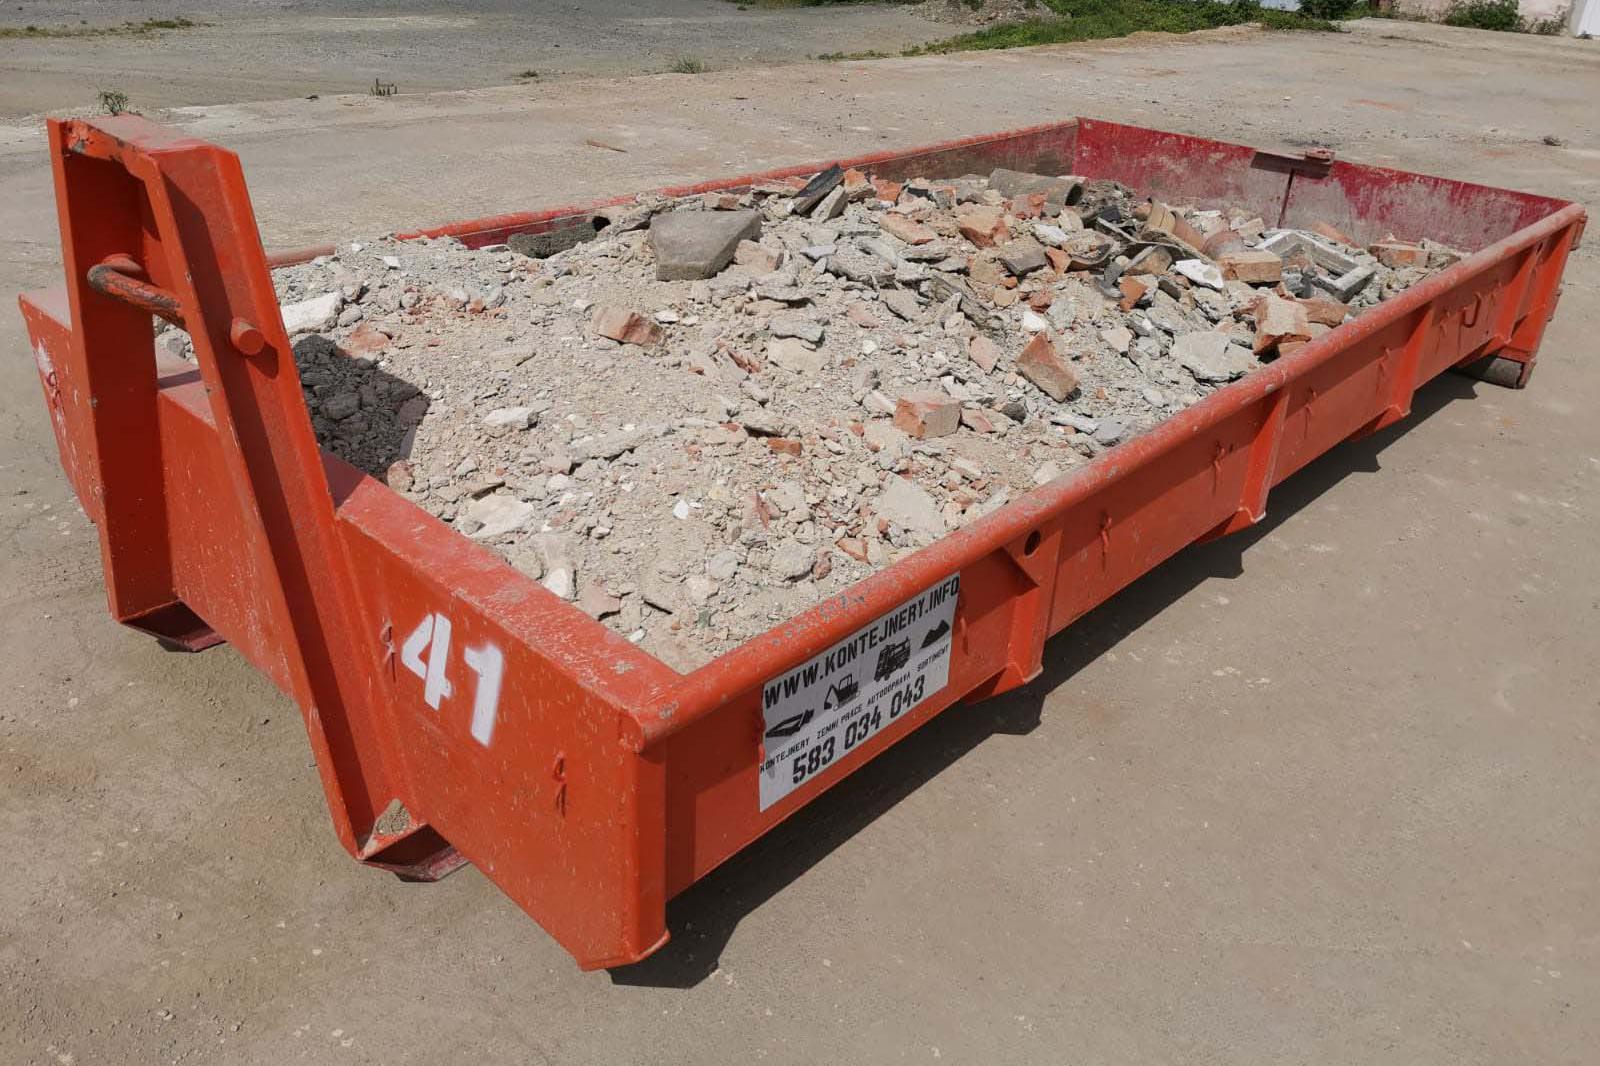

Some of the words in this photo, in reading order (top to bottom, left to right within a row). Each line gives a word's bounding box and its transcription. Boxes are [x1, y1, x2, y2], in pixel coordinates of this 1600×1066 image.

[401, 613, 504, 747] 41
[764, 577, 960, 708] WWW.KONTEJNERY.INFO
[792, 736, 835, 784] 583
[844, 705, 882, 751] 034
[890, 674, 926, 719] 043
